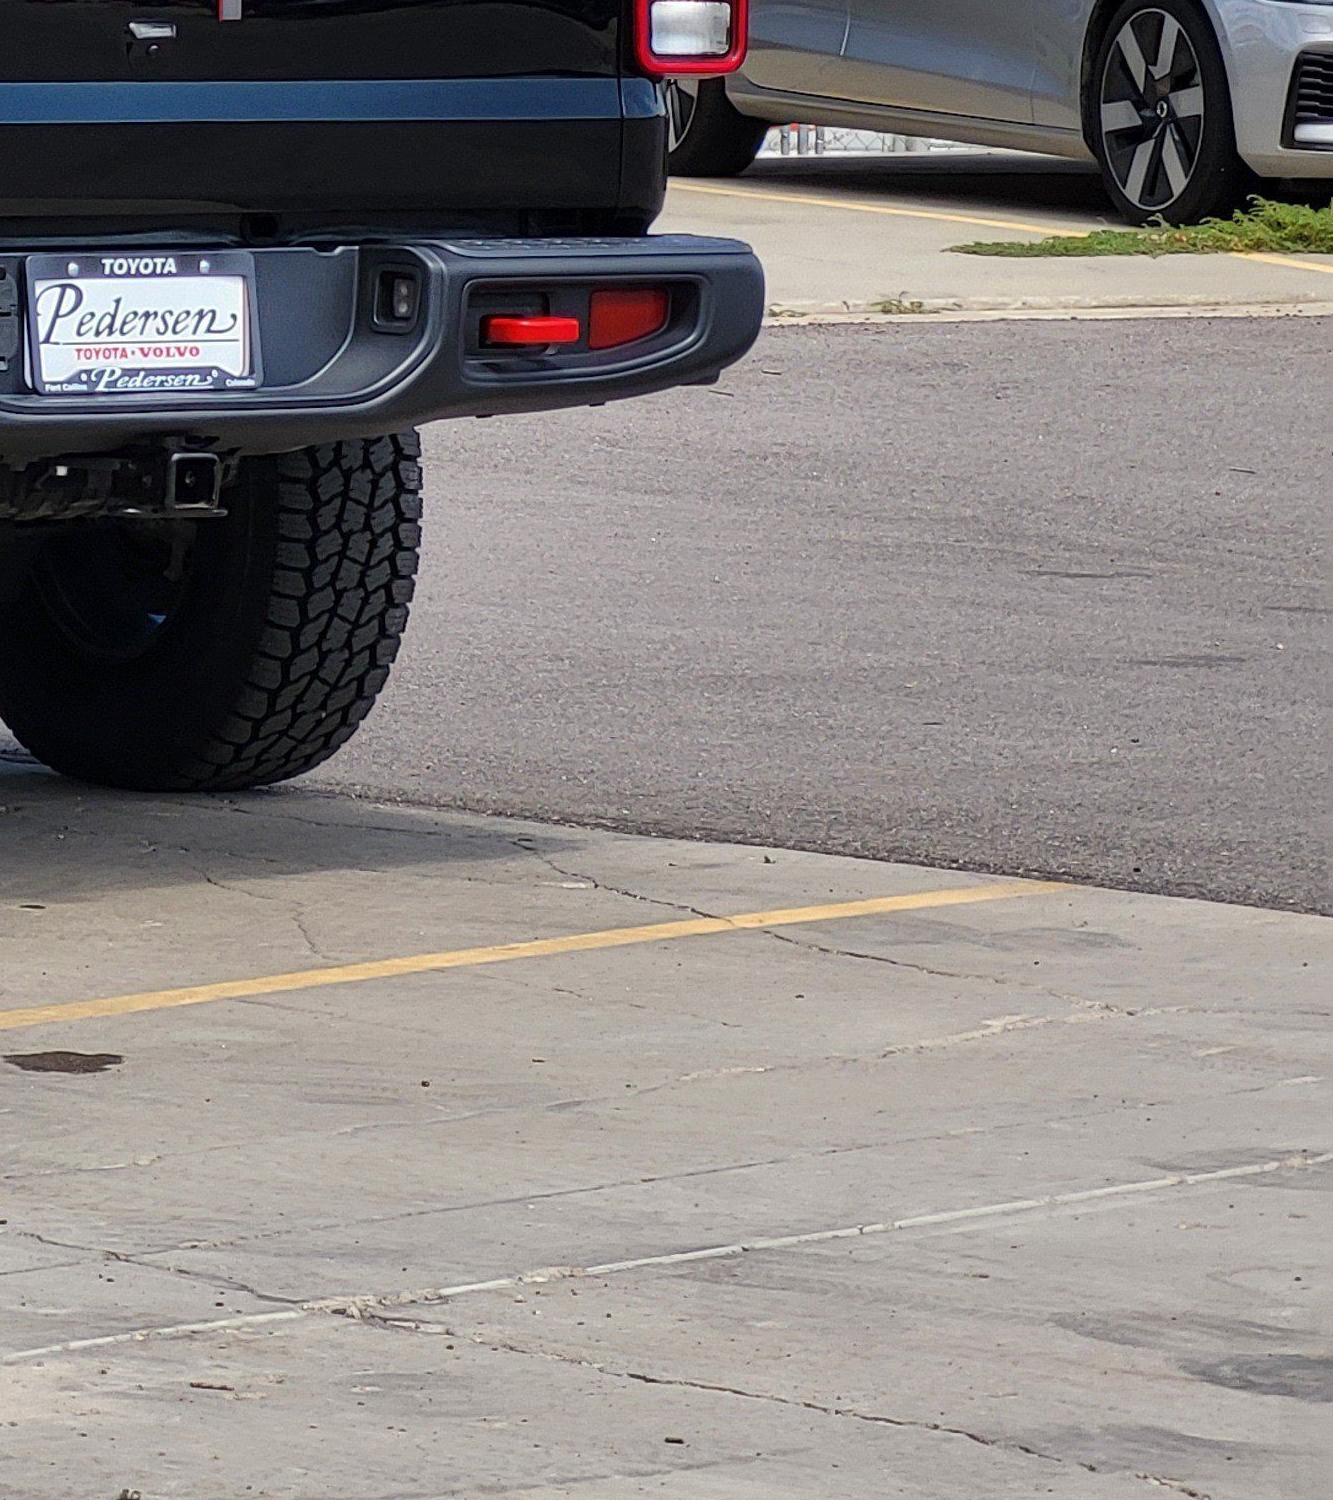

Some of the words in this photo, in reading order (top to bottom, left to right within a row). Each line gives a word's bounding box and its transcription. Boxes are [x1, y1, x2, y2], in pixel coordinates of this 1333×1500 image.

[101, 257, 177, 276] TOYOTA
[35, 283, 238, 346] Pedersen
[74, 347, 129, 362] TOYOTA
[141, 345, 201, 360] VOLVO
[90, 367, 214, 392] Pedersen
